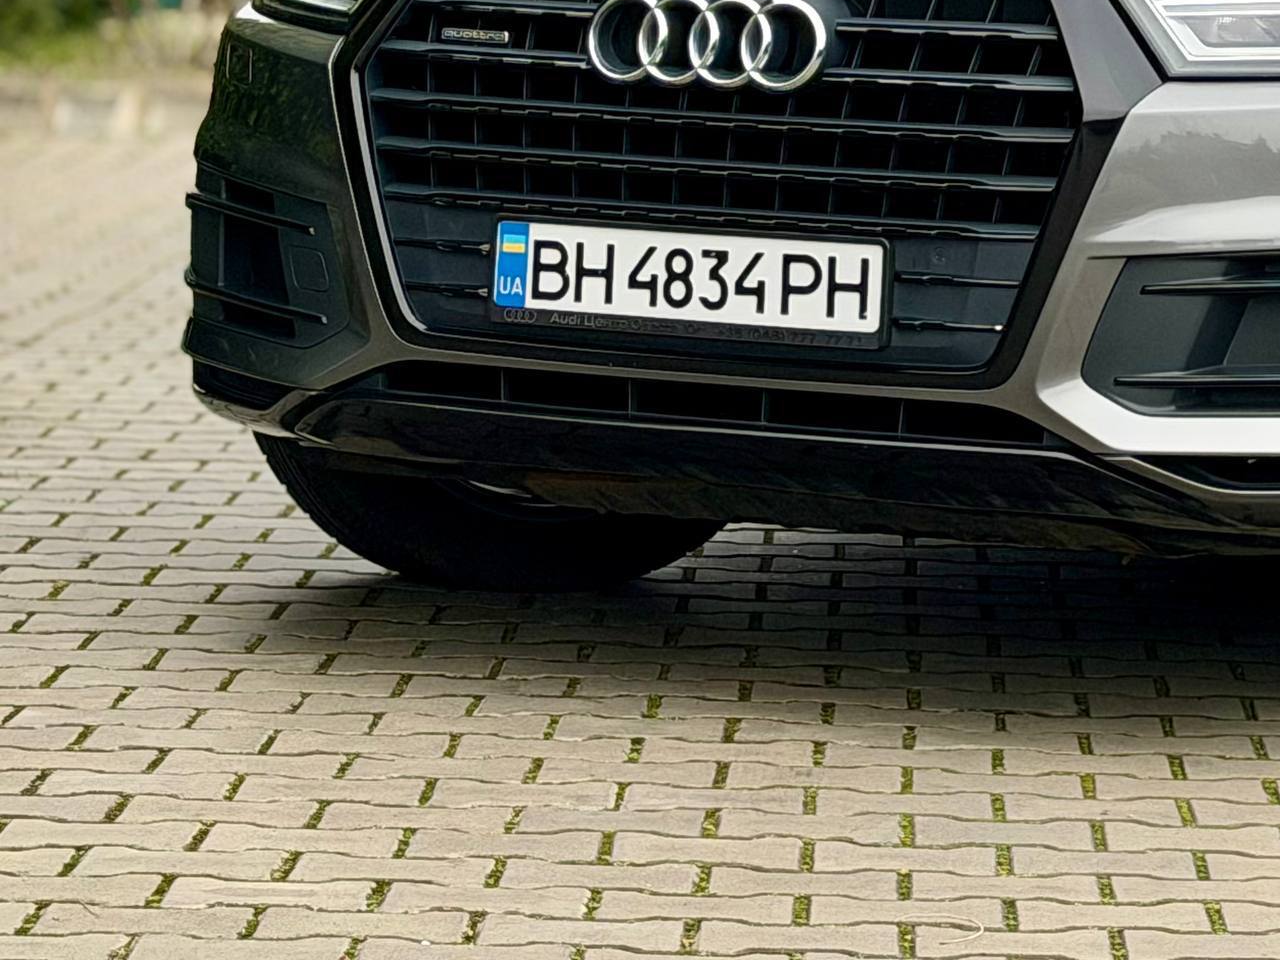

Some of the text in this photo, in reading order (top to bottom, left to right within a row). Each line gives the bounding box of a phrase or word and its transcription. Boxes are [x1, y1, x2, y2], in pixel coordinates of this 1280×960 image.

[443, 29, 505, 41] quattro
[500, 276, 523, 295] UA
[550, 312, 581, 326] Audi
